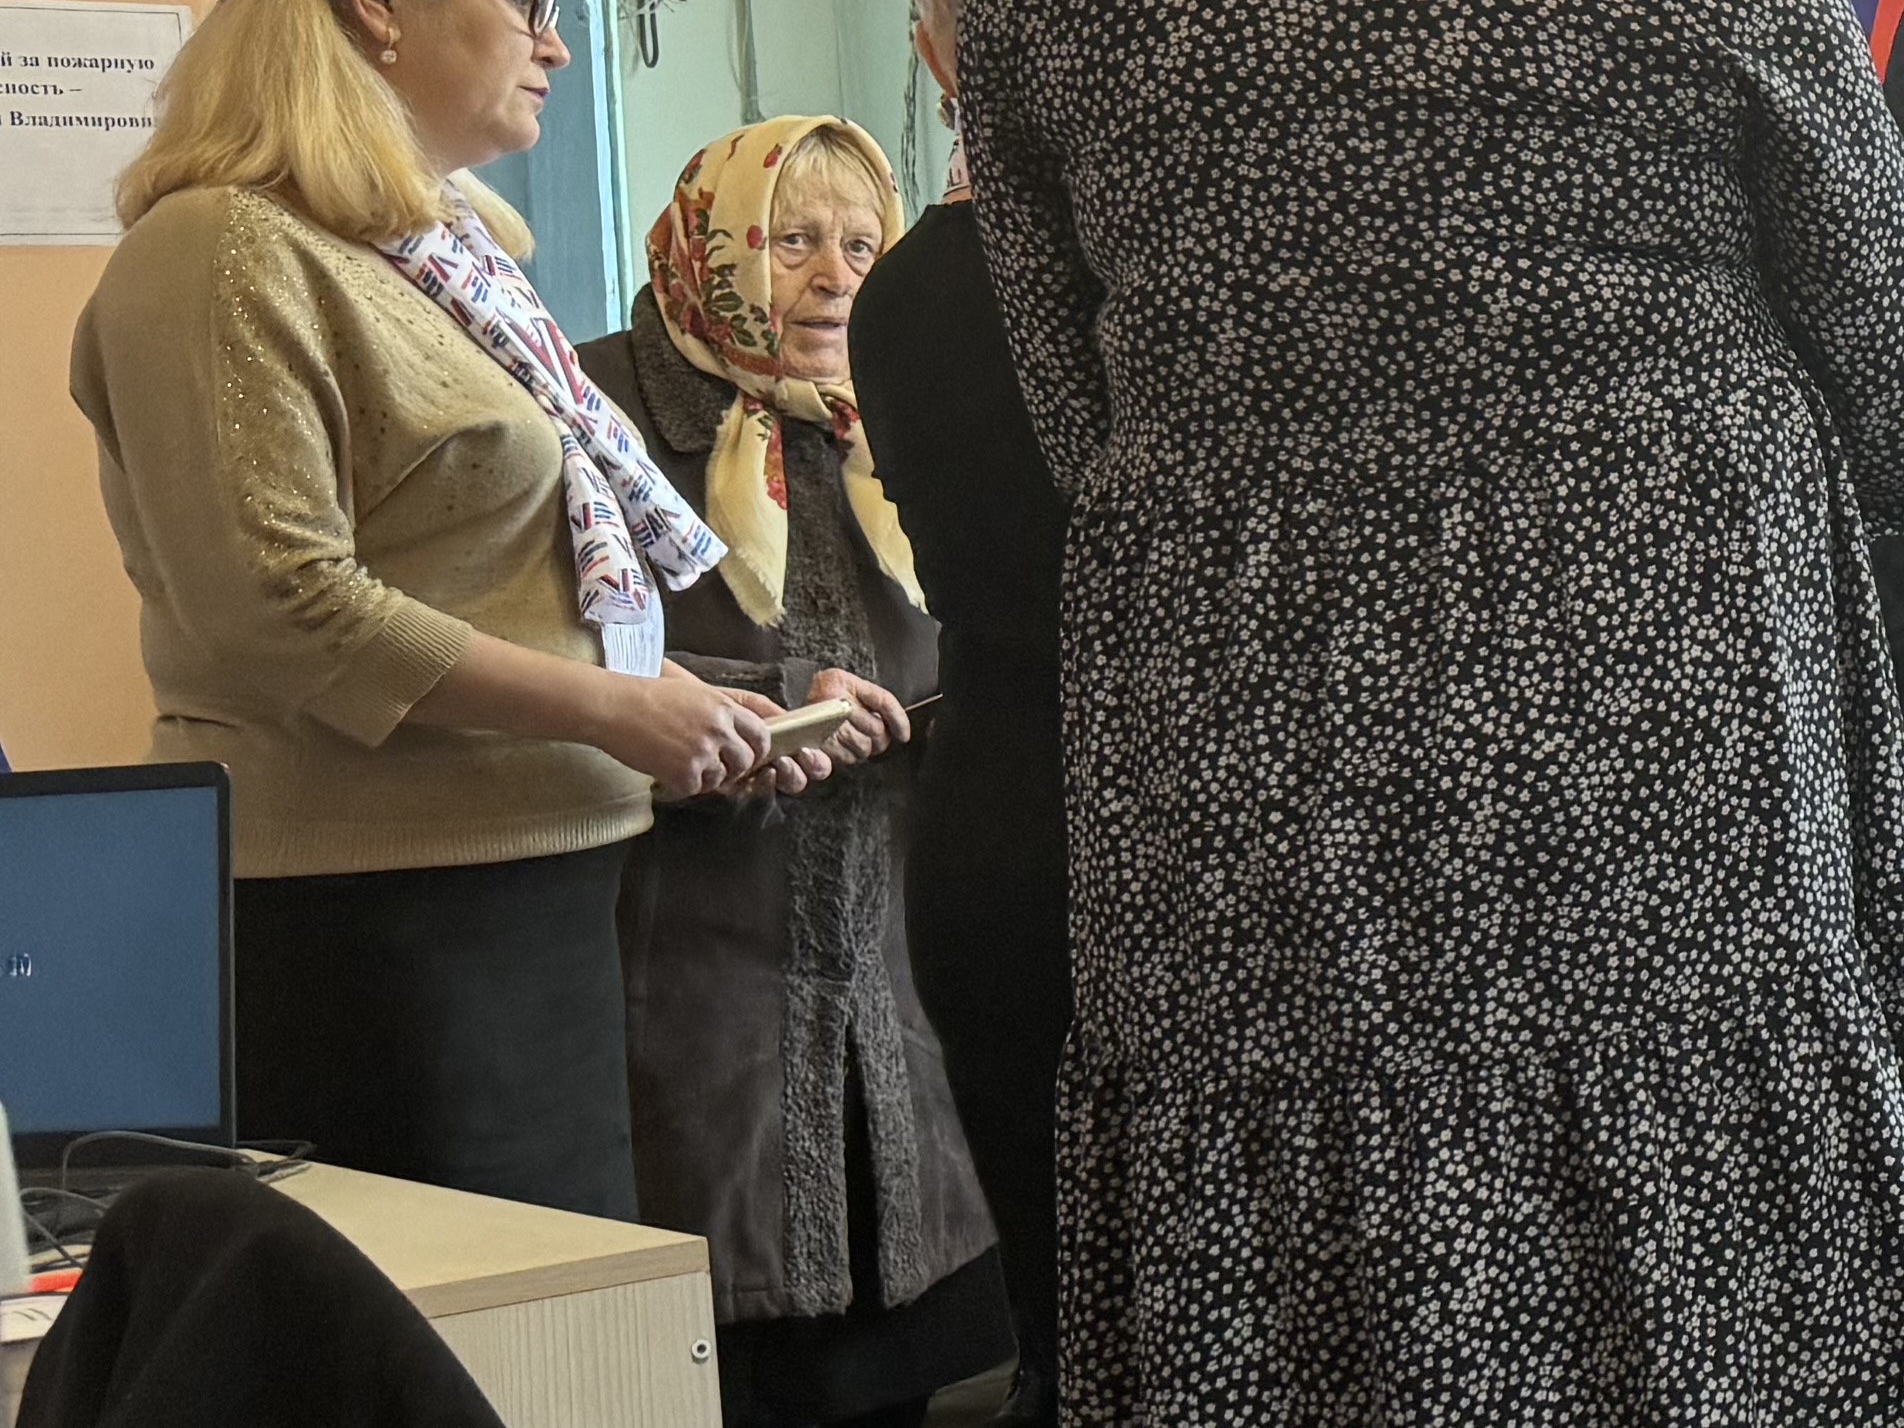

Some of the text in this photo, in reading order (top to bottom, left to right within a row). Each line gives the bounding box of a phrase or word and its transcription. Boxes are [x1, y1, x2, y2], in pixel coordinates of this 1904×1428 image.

[19, 56, 40, 67] за
[47, 56, 155, 73] пожарную
[10, 110, 154, 132] Владимировн
